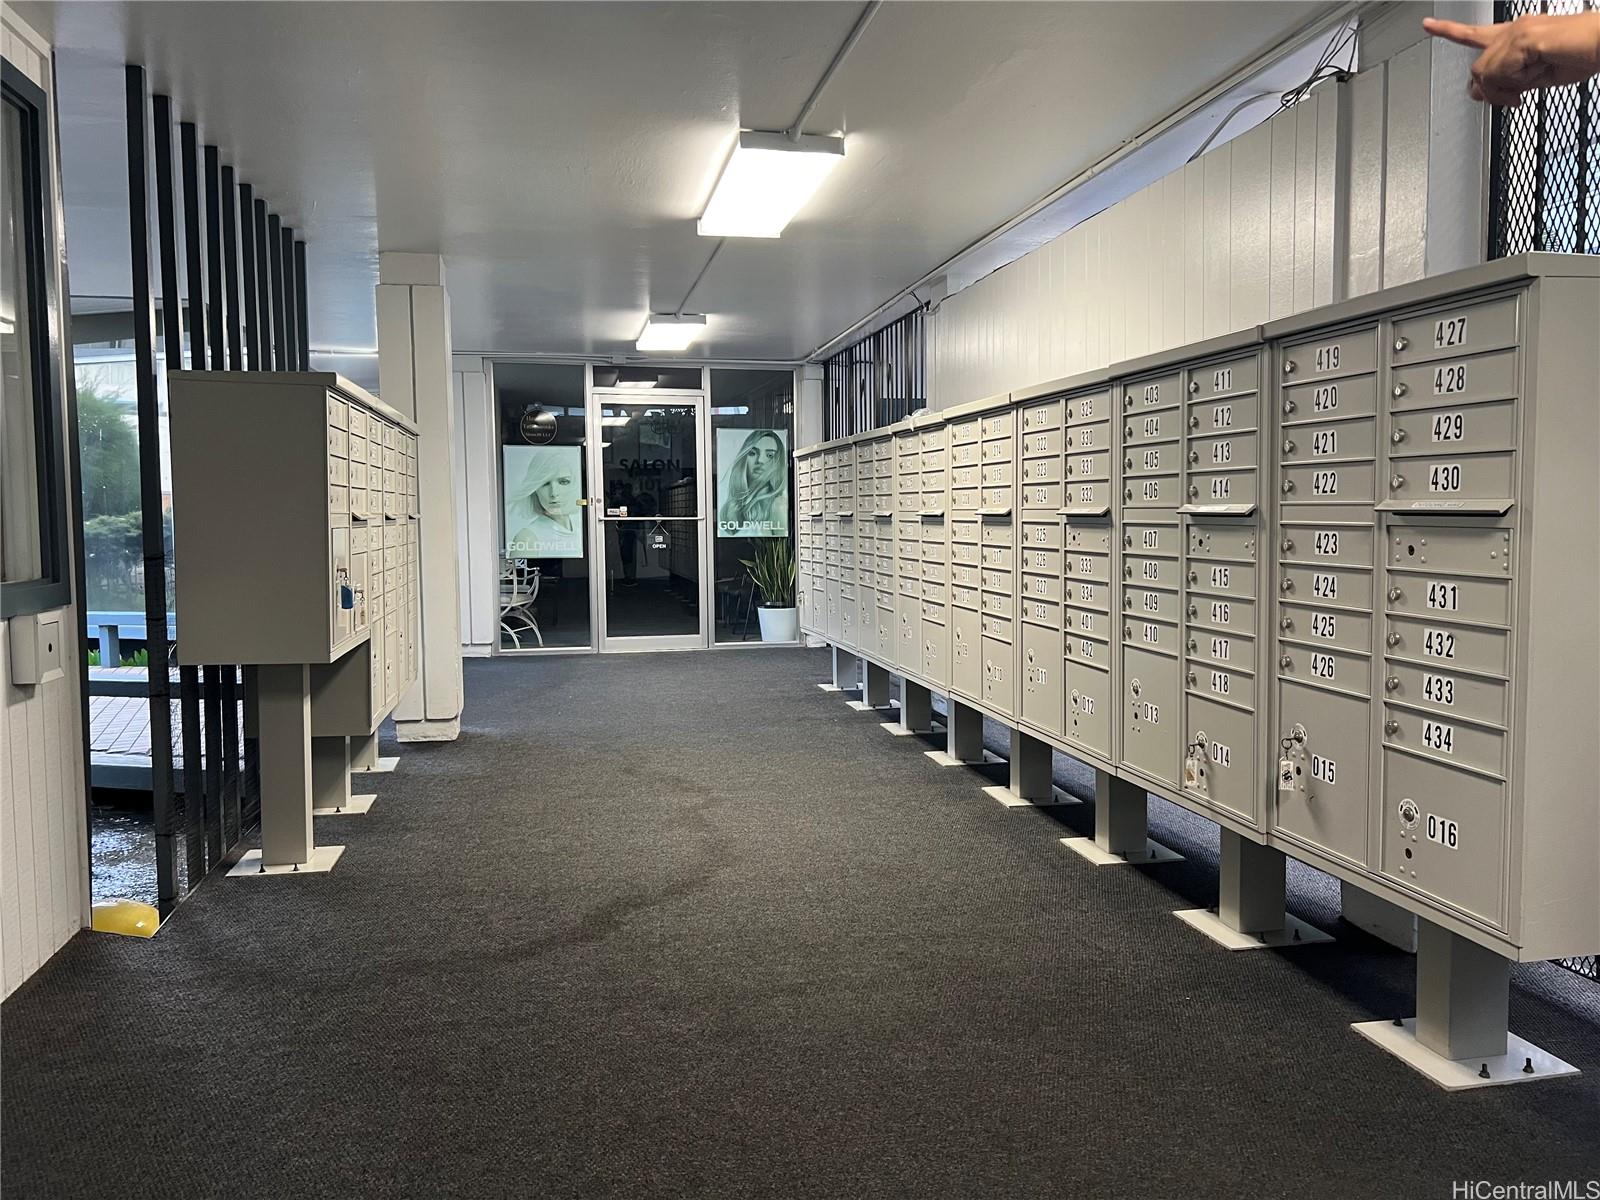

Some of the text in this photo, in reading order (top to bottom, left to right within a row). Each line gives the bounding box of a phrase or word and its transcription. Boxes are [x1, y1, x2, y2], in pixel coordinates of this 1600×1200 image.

[1436, 317, 1466, 346] 427
[1317, 346, 1339, 370] 419
[1214, 369, 1231, 390] 411
[1435, 366, 1465, 393] 428
[1145, 385, 1159, 404] 403
[1315, 386, 1337, 411] 420
[1081, 400, 1093, 417] 329
[1214, 407, 1231, 426] 412
[1145, 418, 1159, 436] 404
[1434, 414, 1463, 441] 429
[1081, 430, 1093, 446] 330
[1314, 431, 1335, 454] 421
[1144, 451, 1159, 468] 405
[1213, 442, 1230, 462] 413
[619, 458, 681, 472] SALON
[1082, 459, 1092, 474] 331
[1212, 478, 1229, 497] 414
[1314, 472, 1336, 494] 422
[1431, 465, 1460, 491] 430
[1081, 486, 1092, 502] 332
[1144, 481, 1158, 499] 406
[719, 520, 785, 531] GOLDWELL
[507, 541, 577, 552] GOLDWELL
[1143, 530, 1157, 548] 407
[1316, 533, 1338, 554] 423
[1081, 558, 1092, 573] 333
[1143, 562, 1158, 580] 408
[1212, 568, 1229, 587] 415
[1314, 575, 1336, 598] 424
[1081, 583, 1093, 601] 334
[1429, 584, 1457, 610] 431
[1144, 594, 1158, 611] 409
[1212, 603, 1229, 622] 416
[1081, 610, 1094, 630] 401
[1312, 614, 1335, 637] 425
[1144, 625, 1158, 642] 410
[1081, 639, 1094, 658] 402
[1212, 639, 1229, 659] 417
[1425, 631, 1454, 658] 432
[1036, 668, 1047, 683] 011
[1312, 654, 1334, 678] 426
[1212, 673, 1229, 693] 418
[1425, 676, 1453, 704] 433
[1082, 696, 1094, 715] 012
[1144, 703, 1159, 724] 013
[1424, 723, 1452, 752] 434
[1213, 743, 1230, 767] 014
[1312, 756, 1335, 783] 015
[1428, 815, 1457, 847] 016
